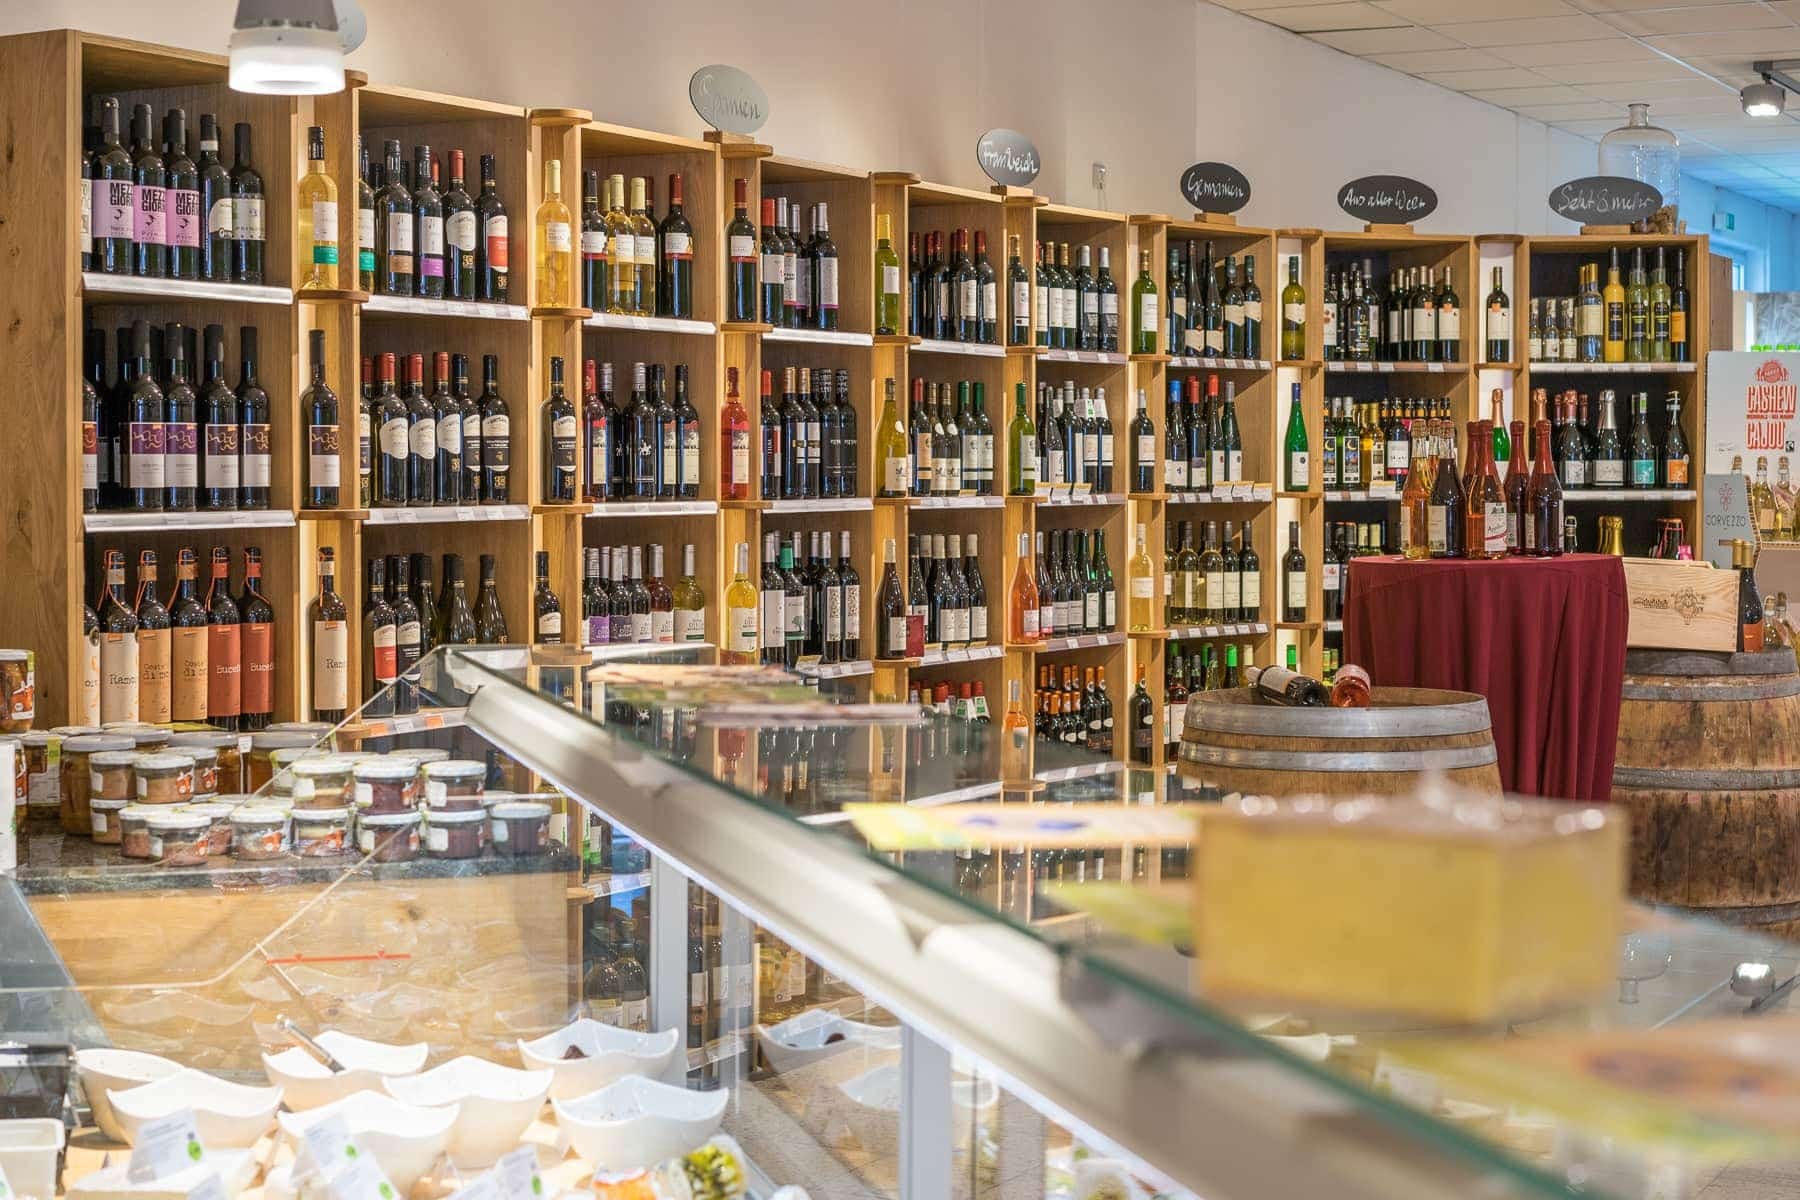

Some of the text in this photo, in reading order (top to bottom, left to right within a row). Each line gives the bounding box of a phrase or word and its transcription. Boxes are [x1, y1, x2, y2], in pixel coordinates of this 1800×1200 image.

[1746, 384, 1797, 413] CASHEW
[1746, 421, 1785, 450] CAJOU
[1705, 514, 1746, 527] CORVEZZO
